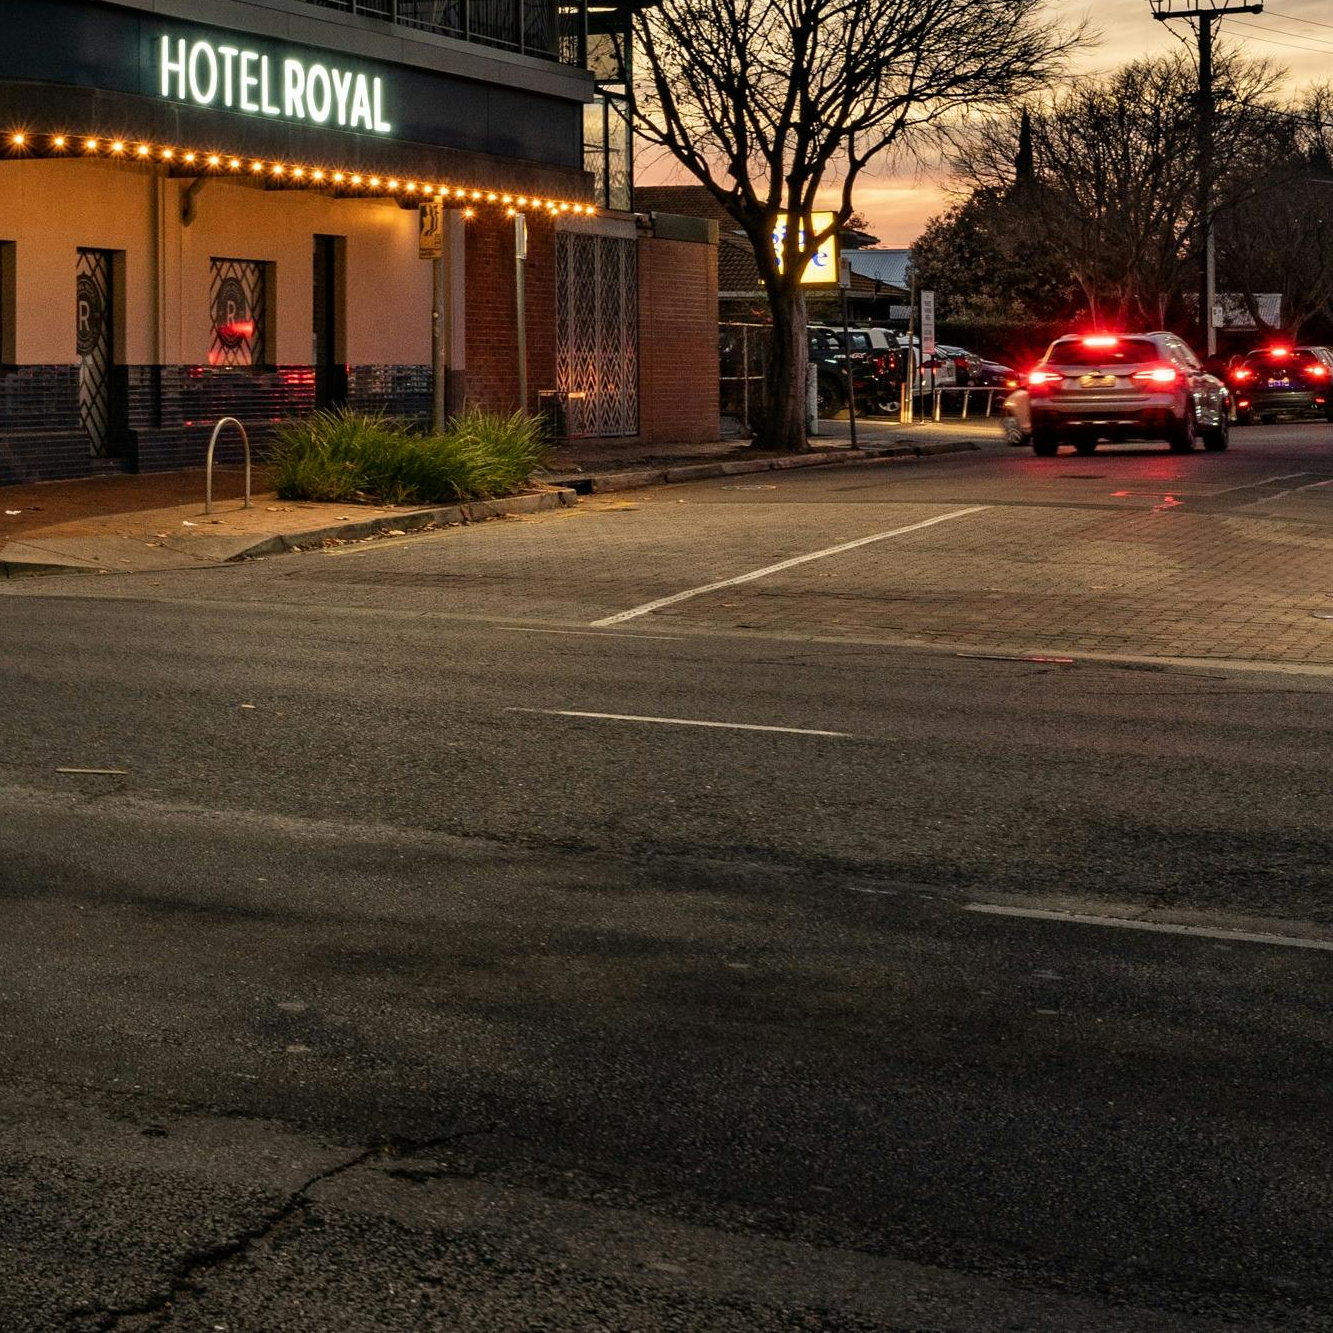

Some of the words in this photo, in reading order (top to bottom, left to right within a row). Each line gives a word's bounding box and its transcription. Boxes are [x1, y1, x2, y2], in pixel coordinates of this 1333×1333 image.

[161, 34, 281, 115] HOTEL
[284, 59, 391, 133] ROYAL
[79, 301, 90, 330] R
